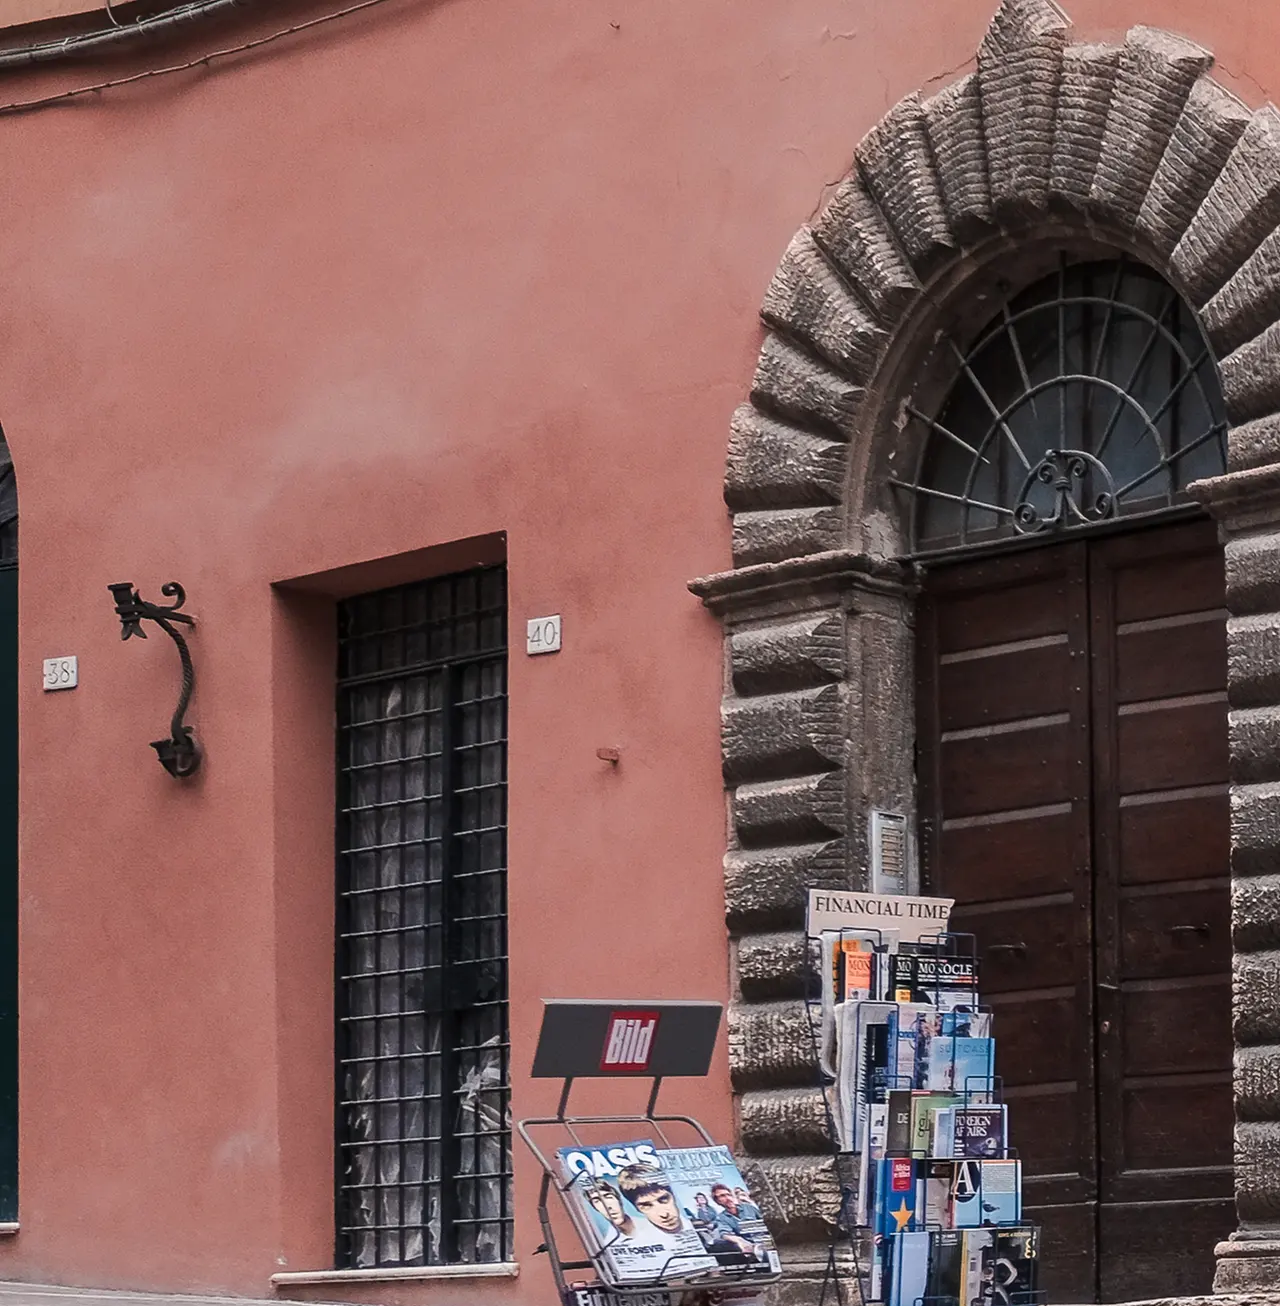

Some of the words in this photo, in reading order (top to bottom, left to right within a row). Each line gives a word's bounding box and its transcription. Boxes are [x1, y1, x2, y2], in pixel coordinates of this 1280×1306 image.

[529, 621, 557, 647] 40
[47, 660, 71, 685] 38
[815, 896, 903, 917] FINANCIAL
[917, 963, 973, 975] MONOCLE
[604, 1018, 656, 1065] Bild
[955, 1126, 988, 1137] AFAIRS
[566, 1144, 661, 1178] OASIS
